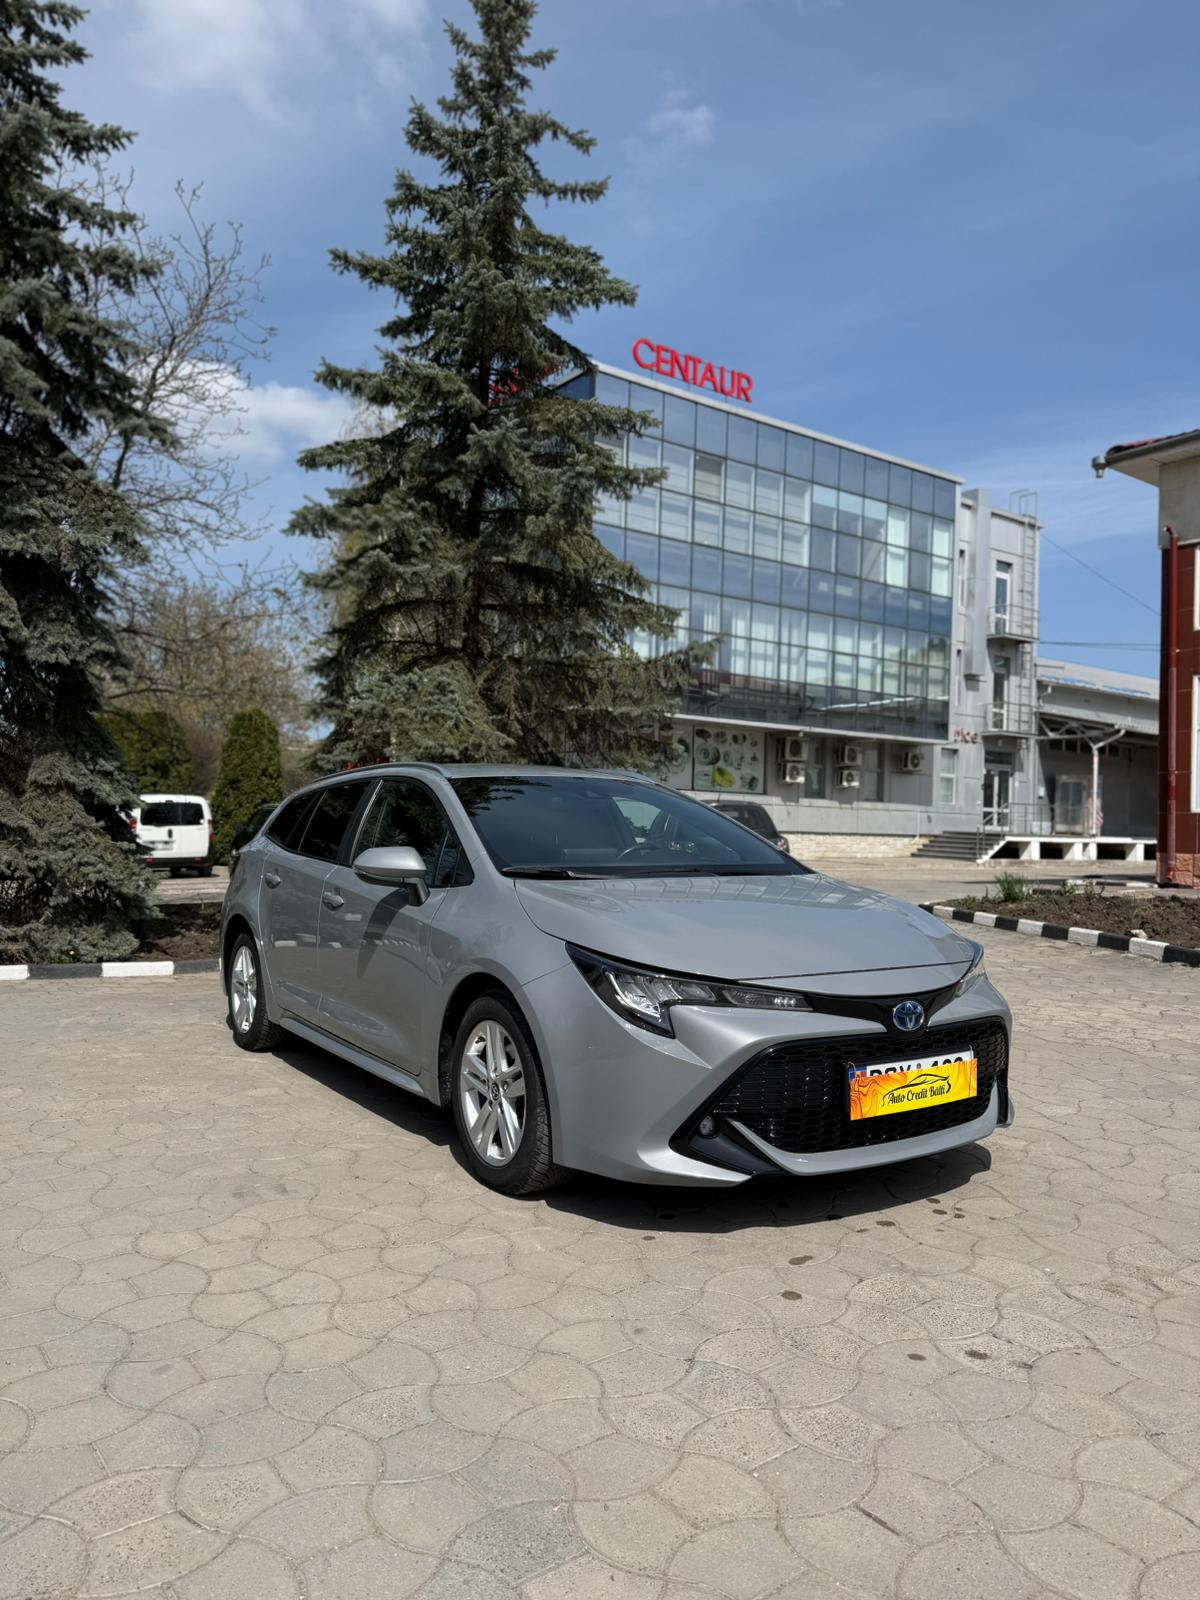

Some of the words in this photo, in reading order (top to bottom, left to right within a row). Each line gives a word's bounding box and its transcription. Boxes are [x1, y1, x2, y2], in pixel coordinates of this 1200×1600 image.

[632, 338, 753, 403] CENTAUR
[888, 1093, 905, 1104] Auto
[907, 1088, 927, 1101] Credit
